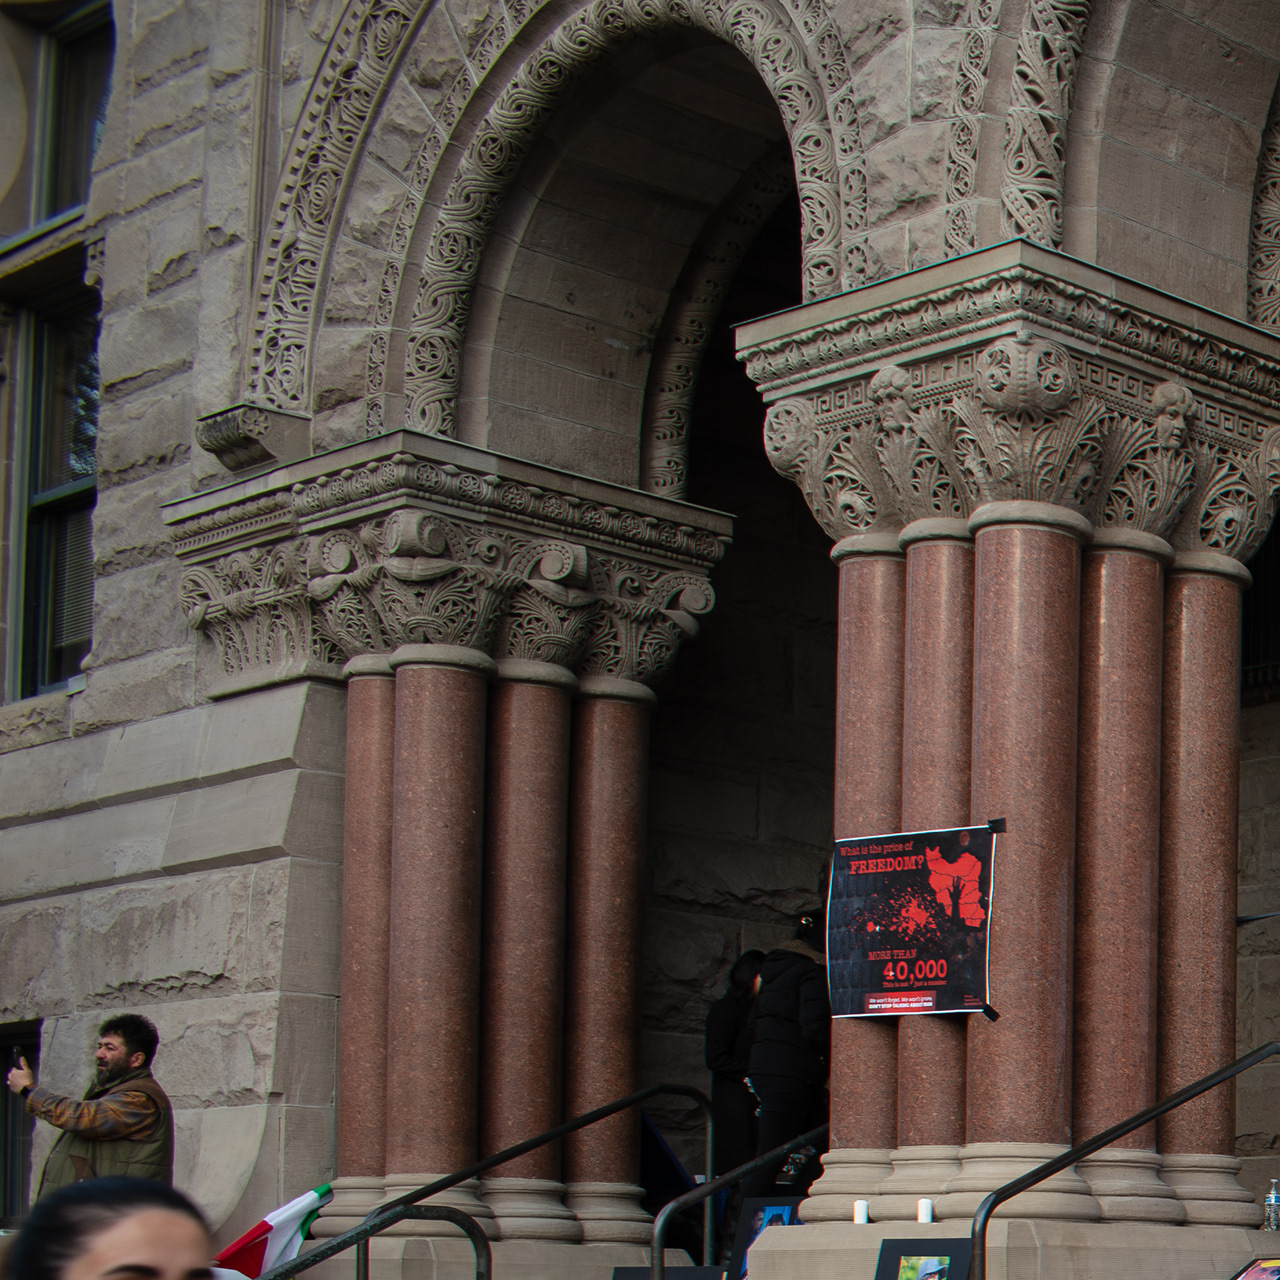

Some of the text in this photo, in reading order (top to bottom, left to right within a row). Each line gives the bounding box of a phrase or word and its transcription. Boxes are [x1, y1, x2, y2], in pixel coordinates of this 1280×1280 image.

[839, 841, 915, 857] What is the price of
[849, 855, 925, 875] FREEDOM?
[892, 949, 917, 960] THAN
[882, 958, 948, 985] 40,000
